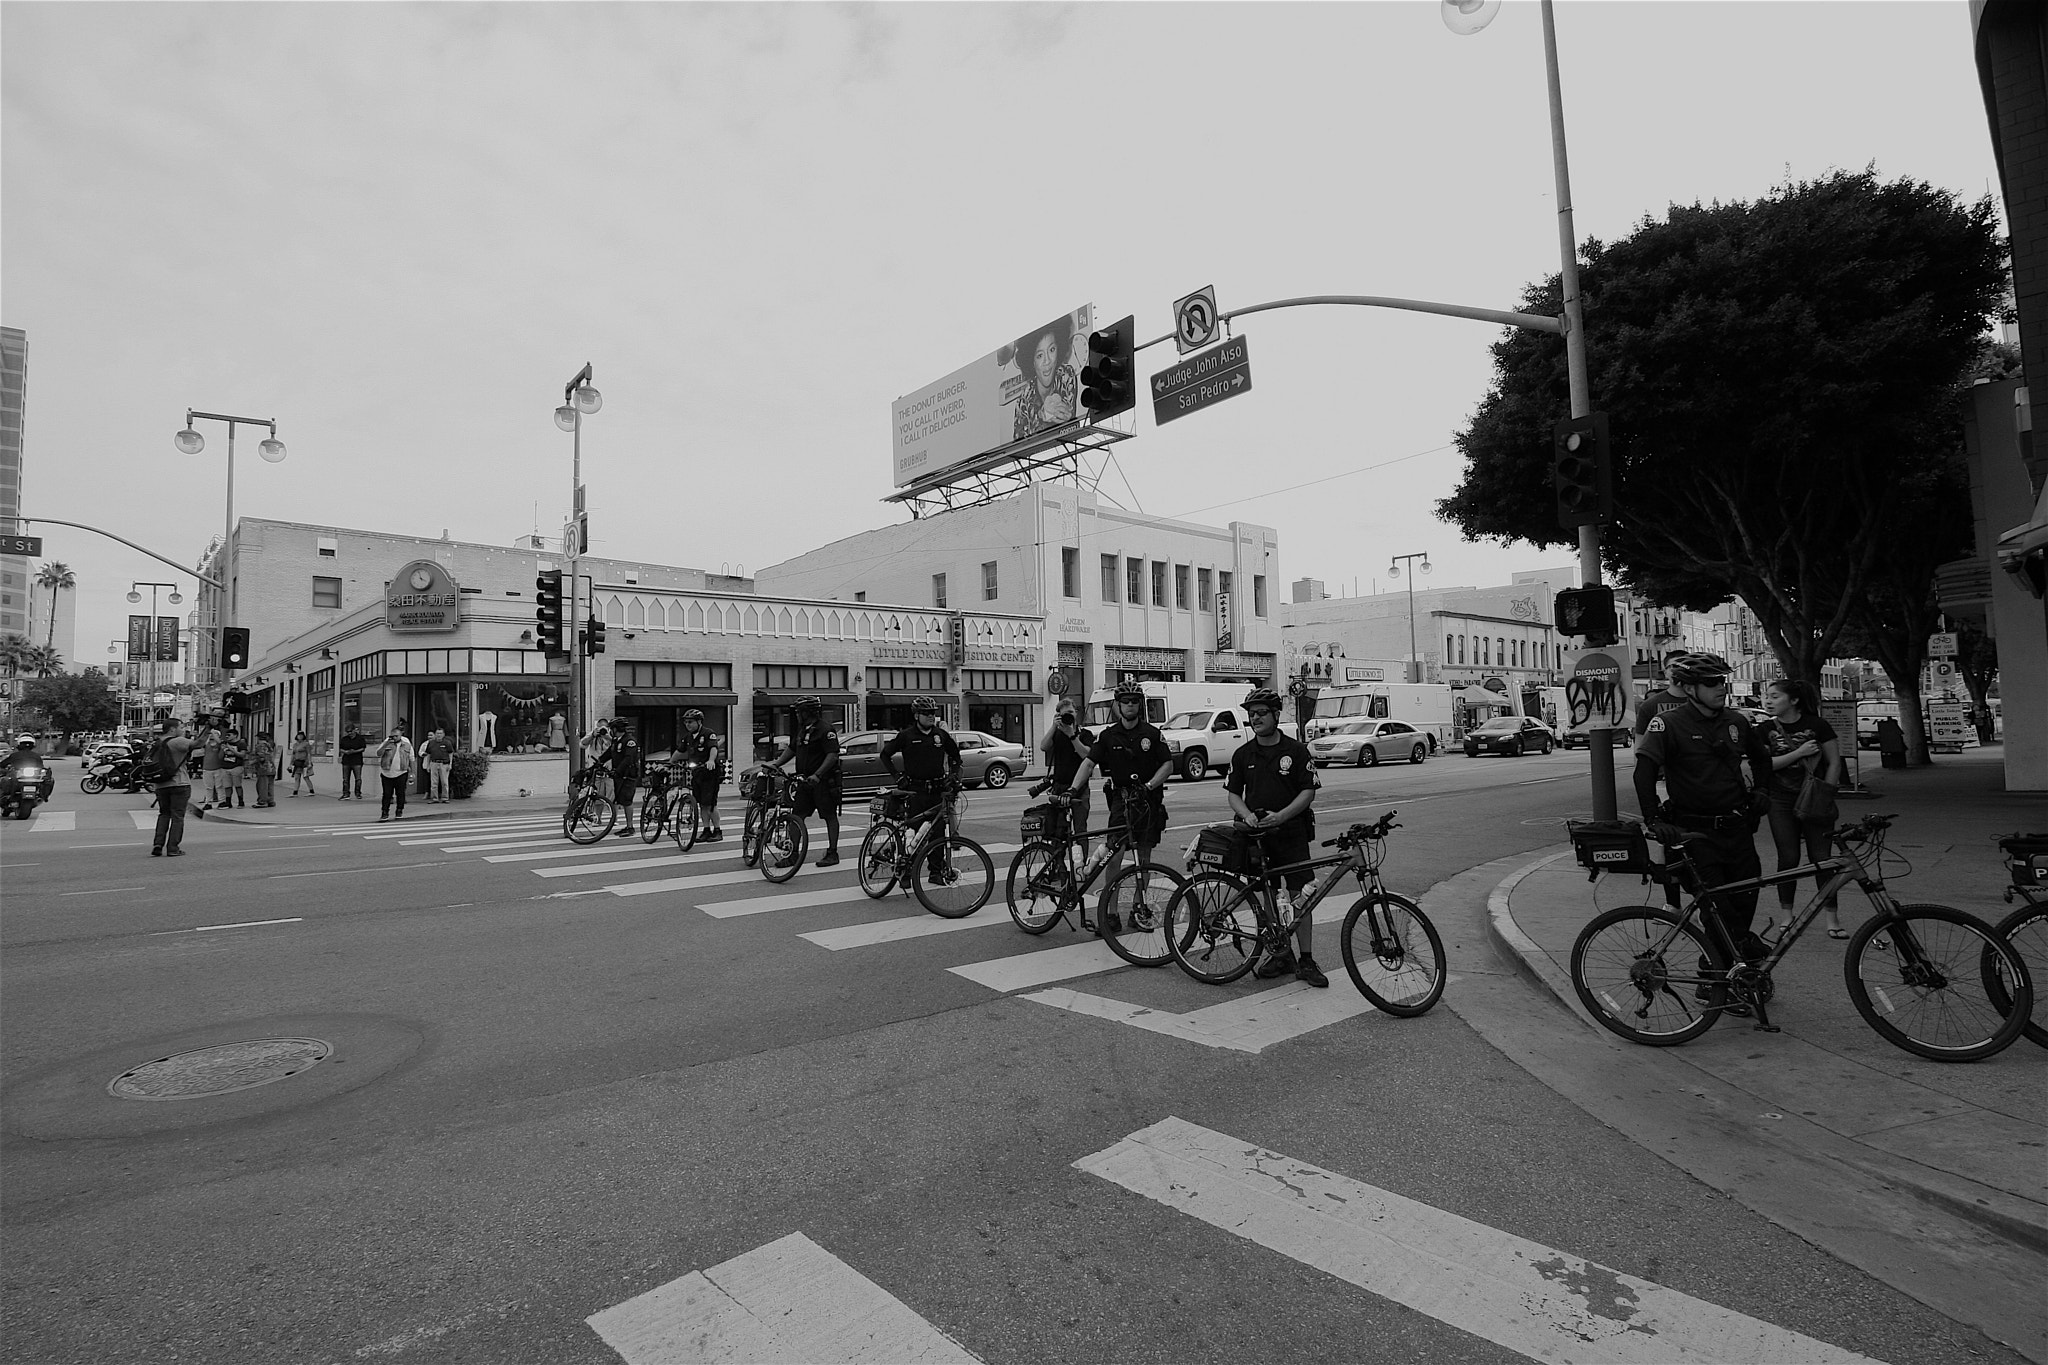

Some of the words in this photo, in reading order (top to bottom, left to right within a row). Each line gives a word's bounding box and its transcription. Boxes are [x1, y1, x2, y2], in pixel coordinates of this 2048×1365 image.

[1165, 367, 1192, 388] Judge
[1194, 355, 1218, 376] John
[898, 407, 911, 421] THE
[912, 394, 936, 414] DONUT
[937, 380, 968, 402] BURGER.
[1178, 392, 1197, 409] San
[1200, 379, 1229, 401] Pedro
[899, 420, 914, 435] YOU
[914, 413, 932, 428] CALL
[933, 409, 939, 419] IT
[939, 398, 966, 417] WEIRD,
[904, 430, 921, 445] CALL
[922, 426, 928, 438] IT
[929, 410, 968, 435] DELICIOUS.
[899, 450, 928, 470] GRUBHUB
[15, 540, 33, 552] St
[873, 647, 908, 659] LITTLE
[911, 649, 946, 660] TOKYO
[963, 651, 998, 662] ISITOR
[1000, 652, 1035, 662] CENTER
[1575, 667, 1619, 677] DISMOUNT
[1586, 674, 1610, 683] ZONE
